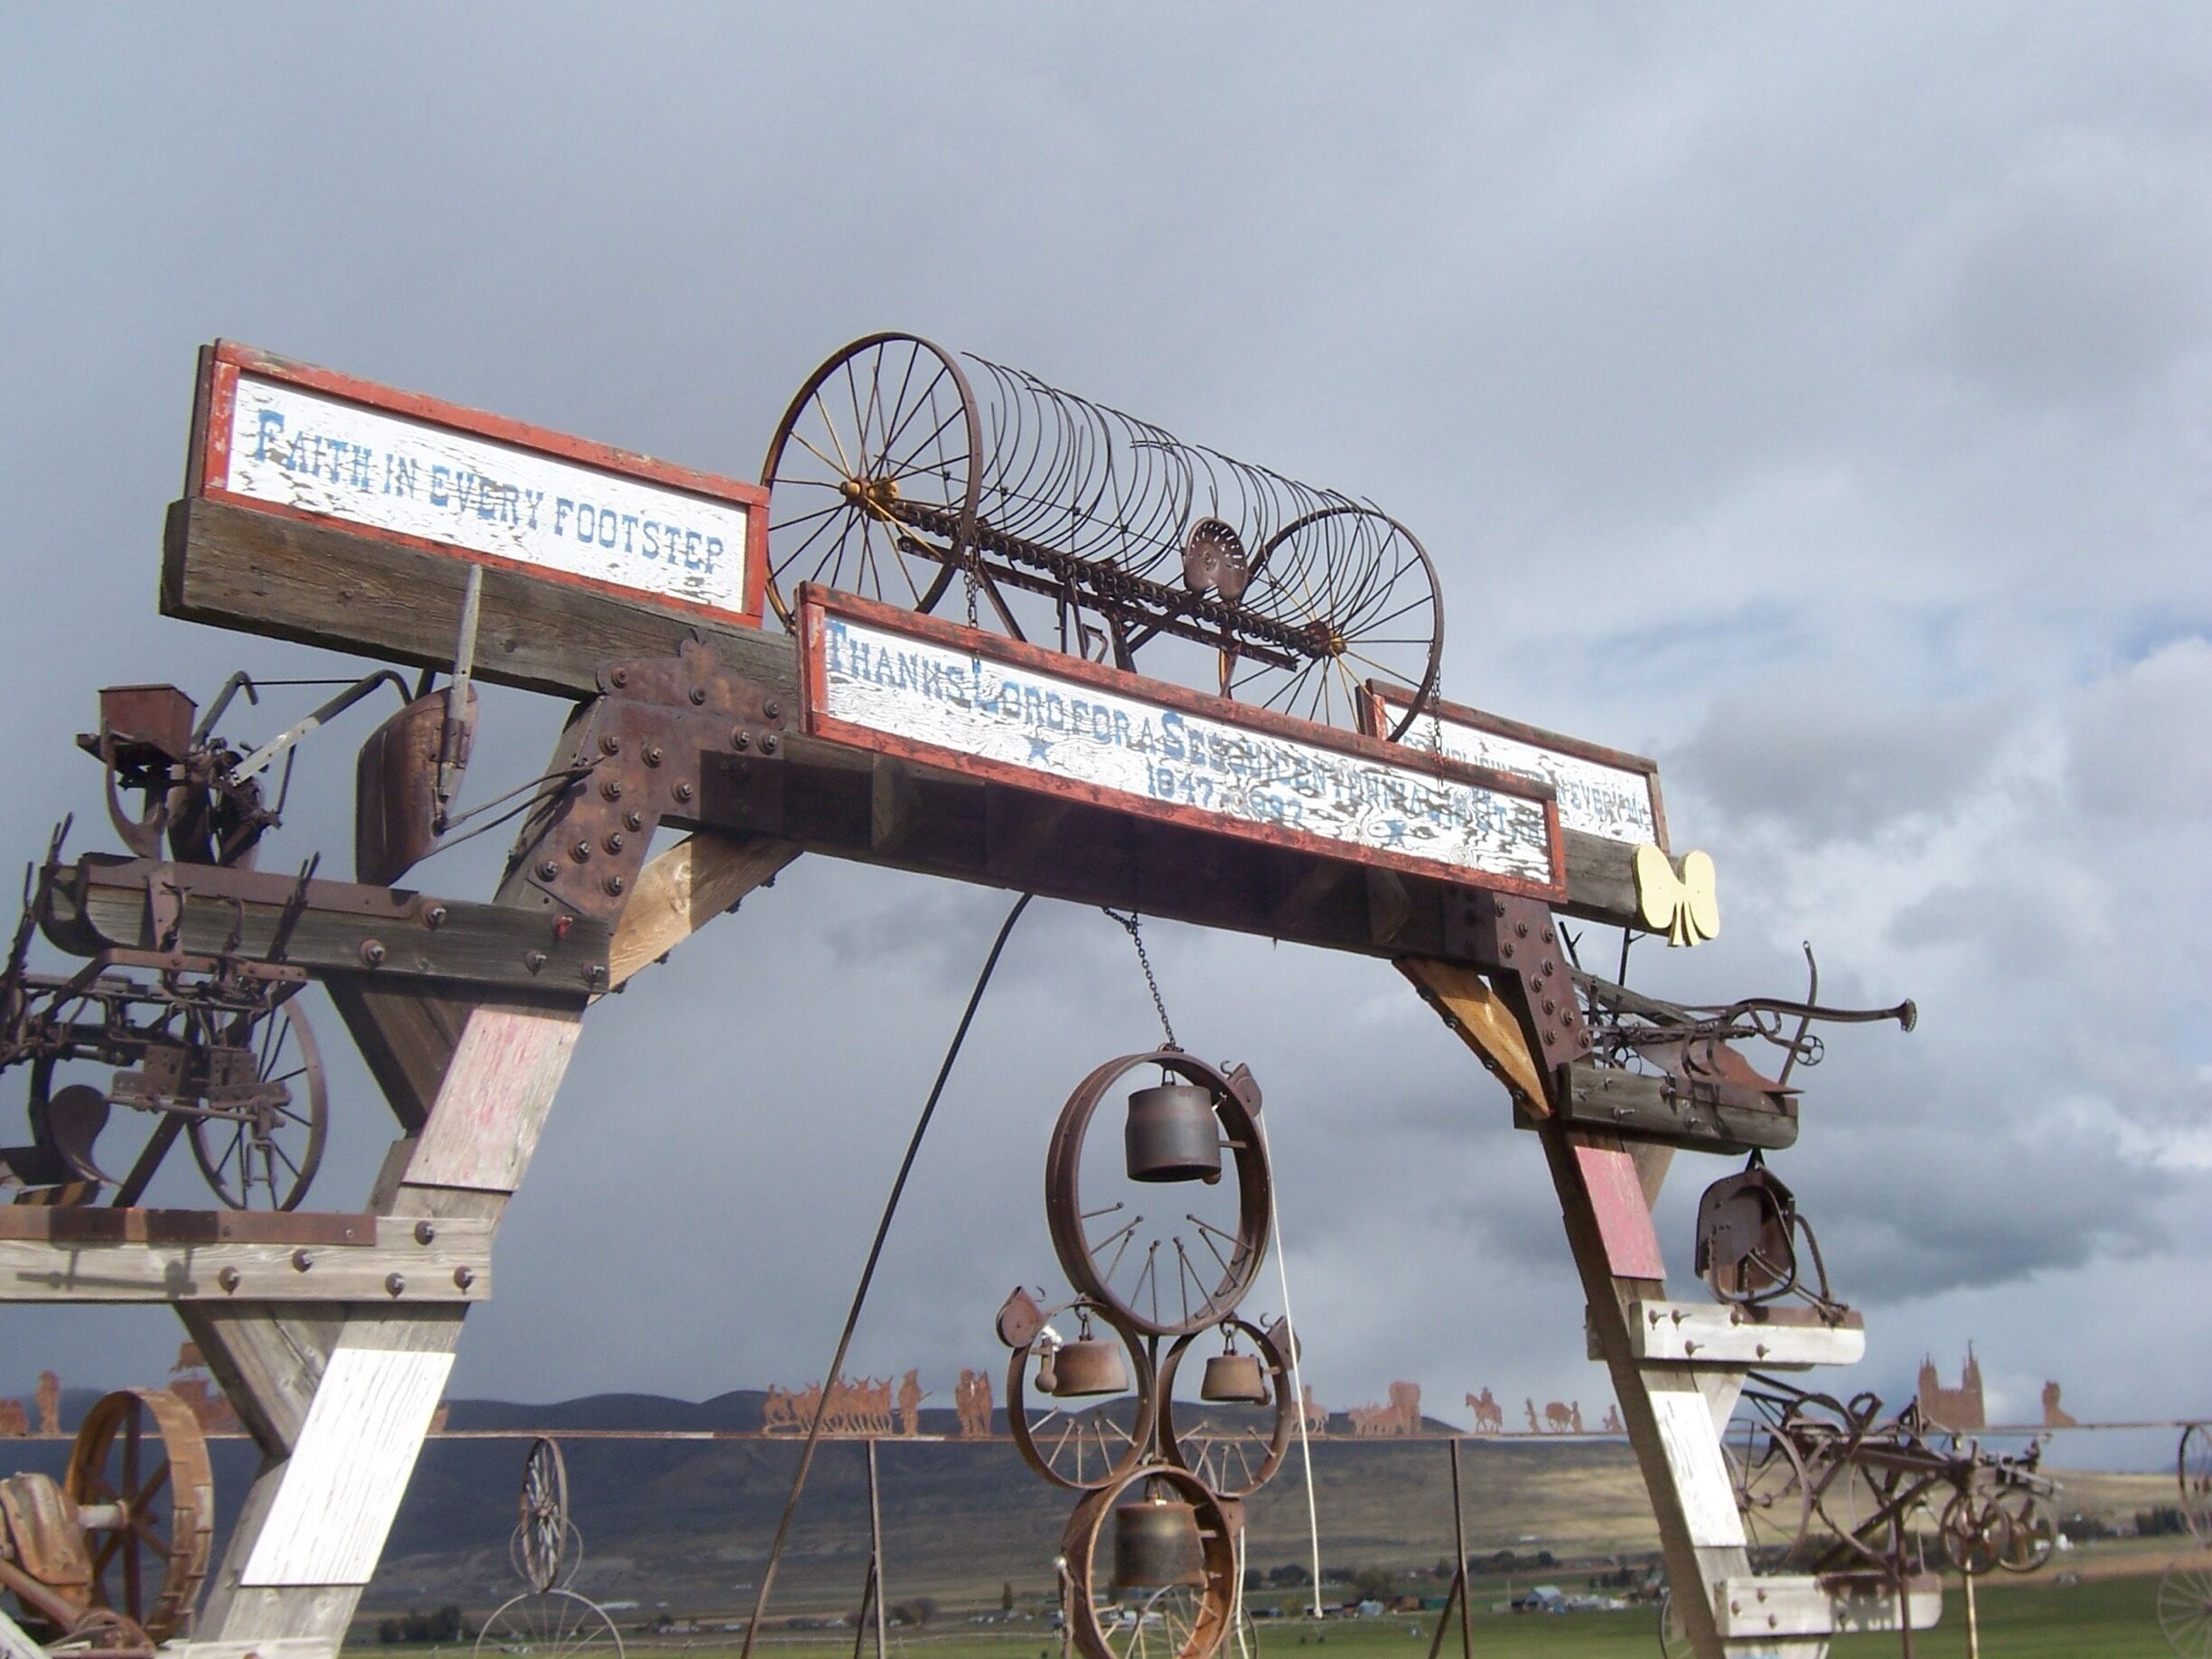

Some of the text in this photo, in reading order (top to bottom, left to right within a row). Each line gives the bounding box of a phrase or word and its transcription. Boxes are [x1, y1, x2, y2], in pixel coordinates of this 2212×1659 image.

[254, 409, 725, 575] FAITH IN EVERY FOOTSTEP
[825, 619, 965, 708] THANKS
[971, 661, 1064, 730] LORD
[1070, 698, 1130, 747] FOR
[1140, 717, 1158, 755] A
[1147, 761, 1214, 807] 1847
